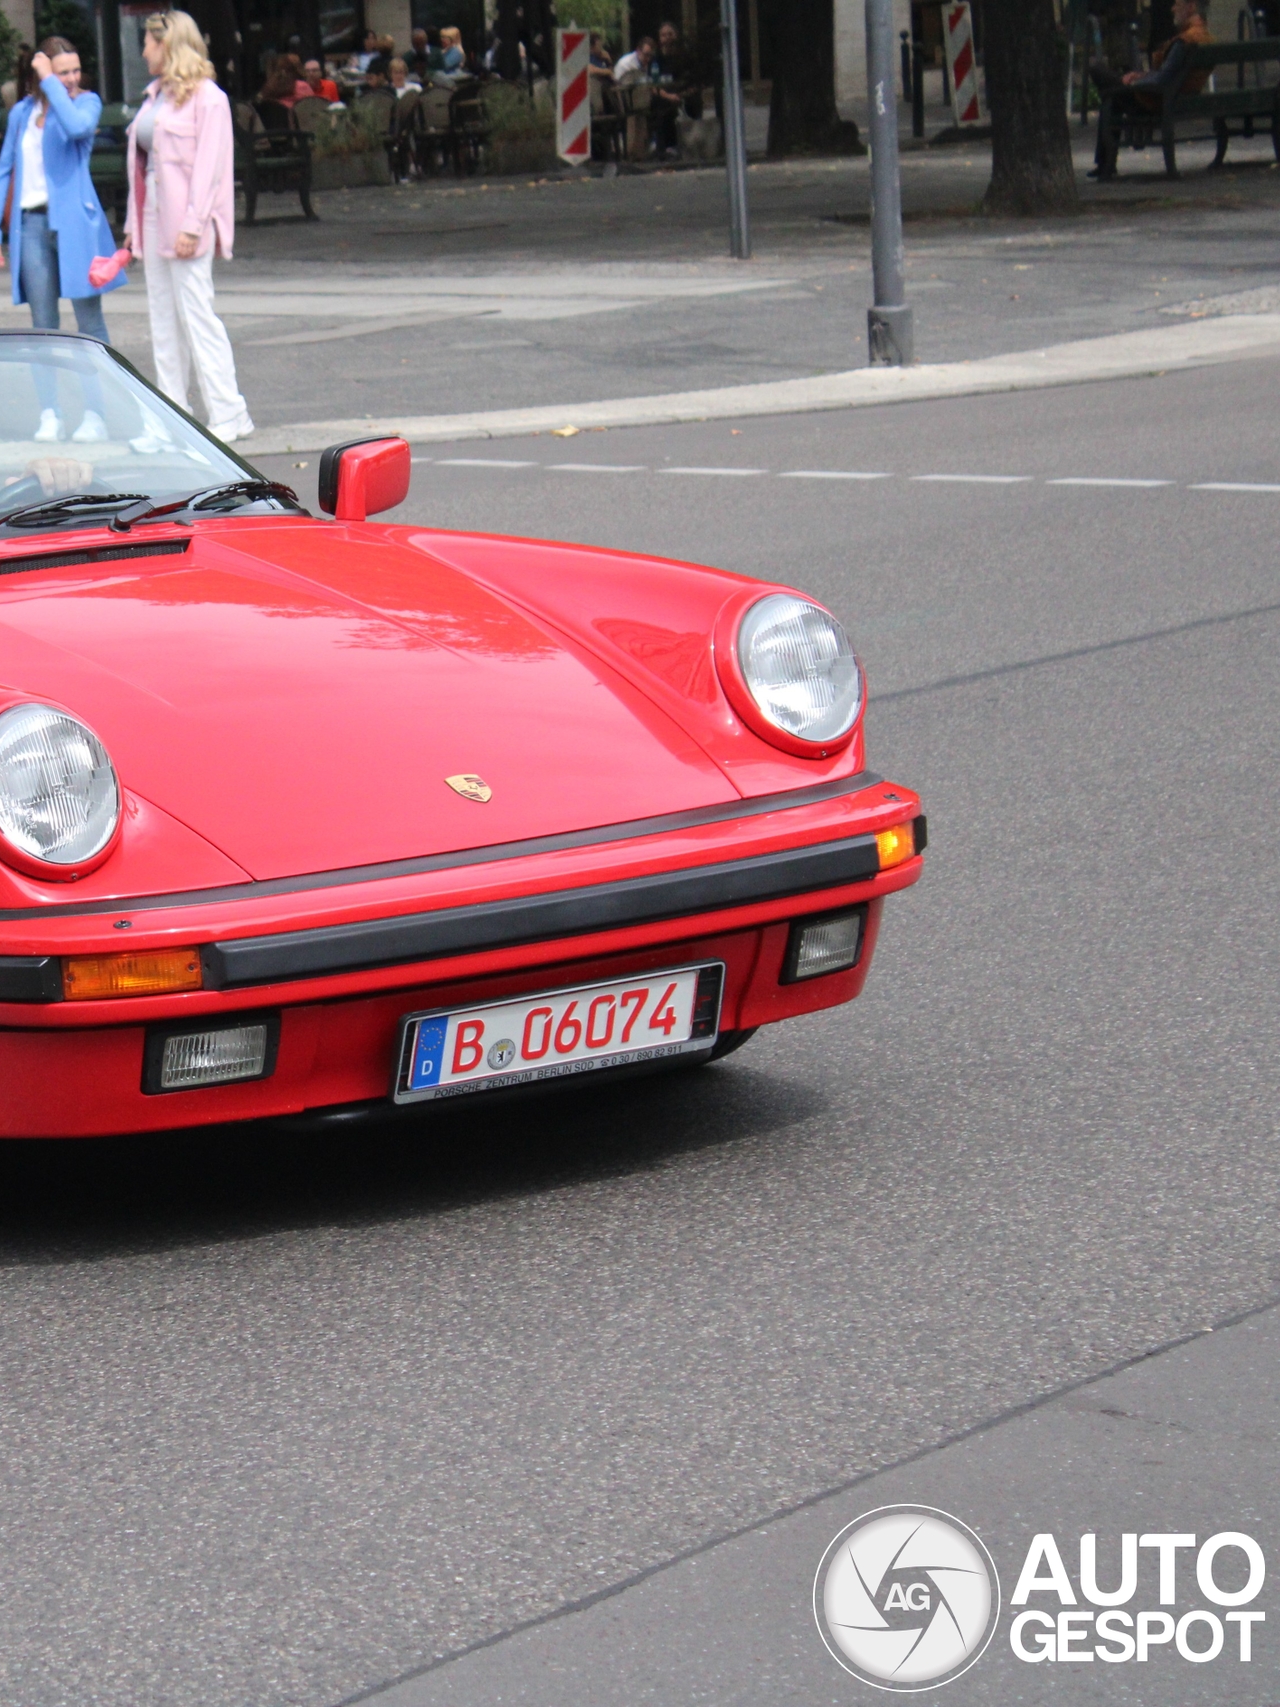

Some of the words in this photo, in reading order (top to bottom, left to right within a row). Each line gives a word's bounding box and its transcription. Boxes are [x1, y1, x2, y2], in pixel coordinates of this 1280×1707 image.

[451, 1018, 485, 1075] B
[521, 982, 678, 1061] 06074
[421, 1060, 433, 1076] D
[434, 1082, 482, 1098] PORSCHE
[486, 1072, 533, 1089] ZENTRUM
[537, 1064, 571, 1080] BERLIN
[637, 1050, 653, 1062] 890
[654, 1047, 665, 1058] 82
[667, 1044, 682, 1056] 911
